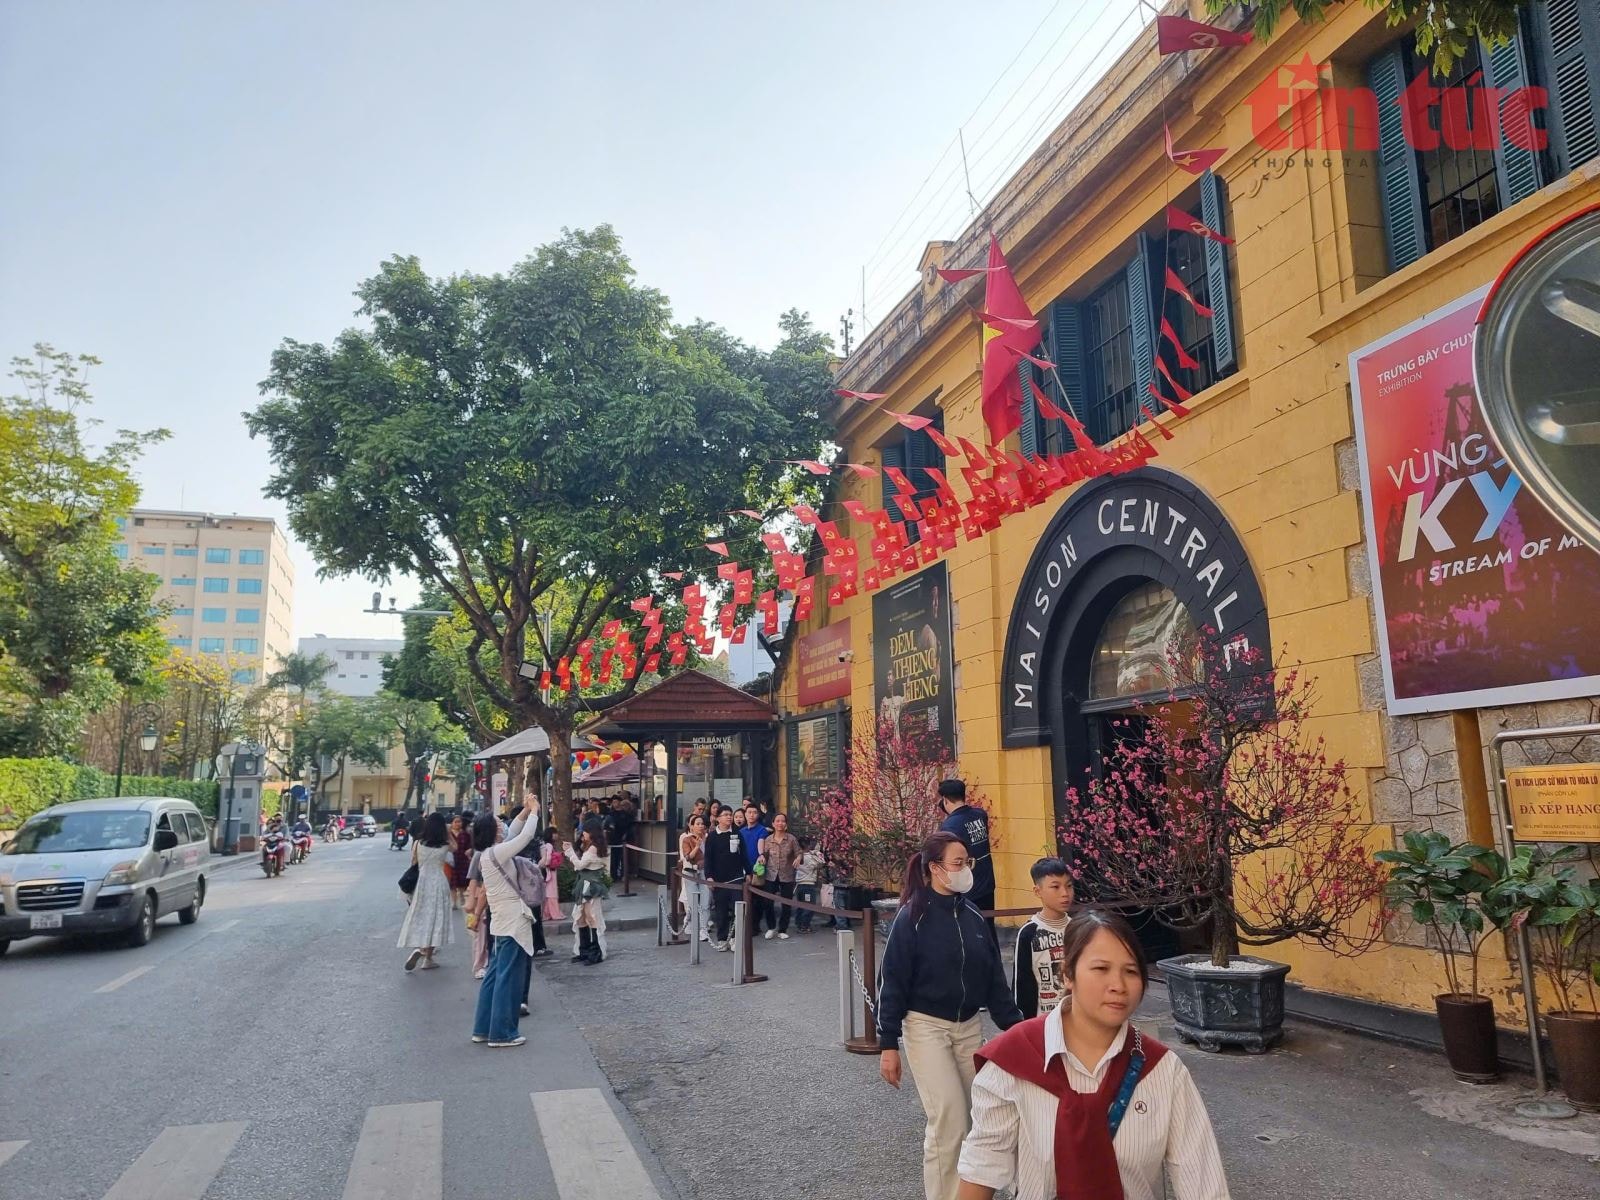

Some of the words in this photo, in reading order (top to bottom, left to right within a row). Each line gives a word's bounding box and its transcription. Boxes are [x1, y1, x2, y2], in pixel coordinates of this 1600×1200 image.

[1377, 356, 1416, 385] TRƯNG
[1417, 348, 1439, 368] BÀY
[1378, 371, 1423, 398] EXHIBITION
[1387, 433, 1488, 491] VÙNG
[1429, 549, 1513, 582] STREAM
[1520, 534, 1552, 561] OF
[1557, 532, 1585, 552] M
[1014, 534, 1077, 708] MAISON
[1097, 498, 1250, 672] CENTRALE
